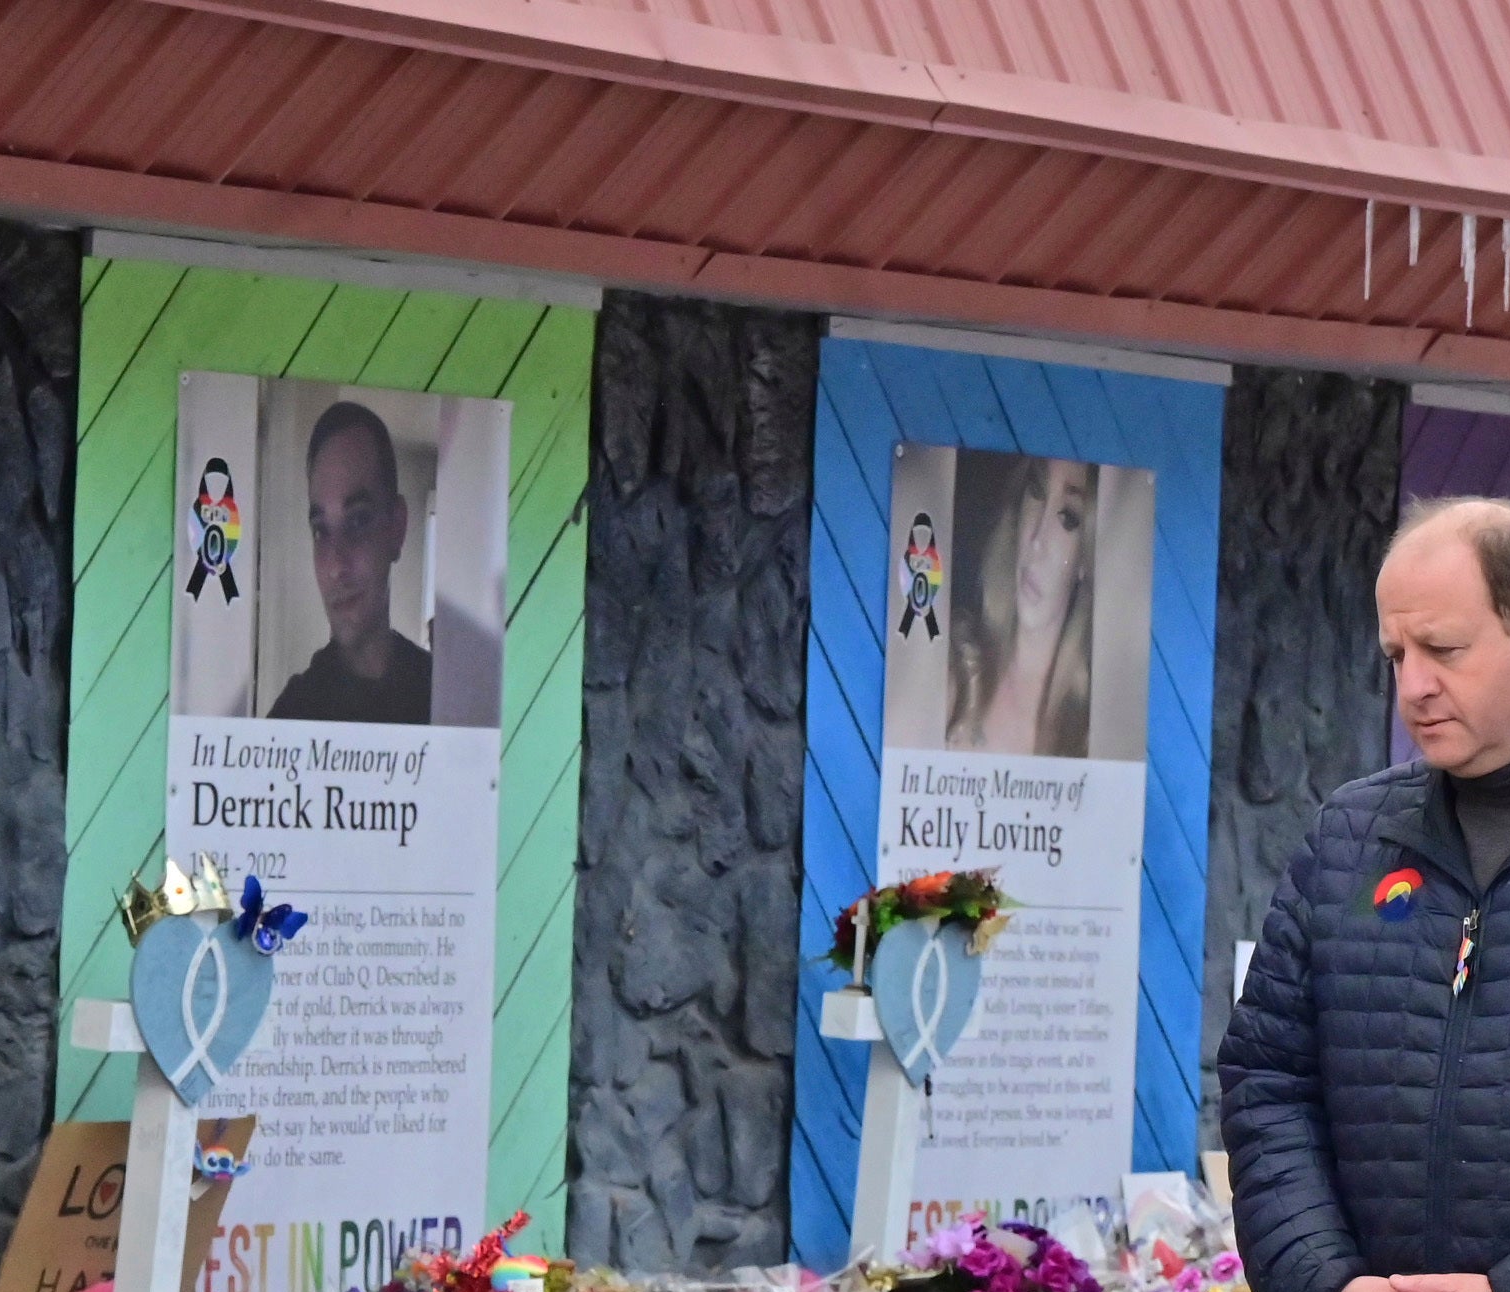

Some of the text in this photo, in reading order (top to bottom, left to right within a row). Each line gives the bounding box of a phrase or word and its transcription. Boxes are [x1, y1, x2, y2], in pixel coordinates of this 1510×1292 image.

[192, 734, 430, 785] In Loving Memory of
[901, 764, 1088, 812] In Loving Memory of
[192, 781, 419, 847] Derrick Rump
[900, 806, 1064, 867] Kelly Loving
[247, 852, 287, 879] 2022
[371, 906, 417, 928] Derrick
[422, 906, 444, 928] had
[449, 912, 466, 928] no
[317, 937, 455, 964] in the community. He
[306, 966, 456, 987] of Club Described as
[285, 996, 299, 1016] of
[340, 996, 387, 1016] Derrick
[392, 1001, 416, 1016] was
[419, 999, 464, 1023] always
[293, 1025, 443, 1050] whether it was through
[245, 1055, 317, 1082] friendship.
[322, 1056, 368, 1076] Derrick
[373, 1058, 383, 1076] is
[386, 1054, 467, 1076] remembered
[273, 1087, 318, 1108] dream,
[323, 1085, 346, 1106] and
[351, 1085, 370, 1105] the
[374, 1084, 417, 1110] people
[421, 1083, 449, 1105] who
[284, 1122, 305, 1144] say
[310, 1116, 325, 1135] he
[393, 1114, 424, 1134] liked
[429, 1114, 448, 1134] for
[264, 1148, 281, 1166] do
[285, 1148, 306, 1166] the
[309, 1151, 347, 1166] same.
[58, 1163, 127, 1219] LO
